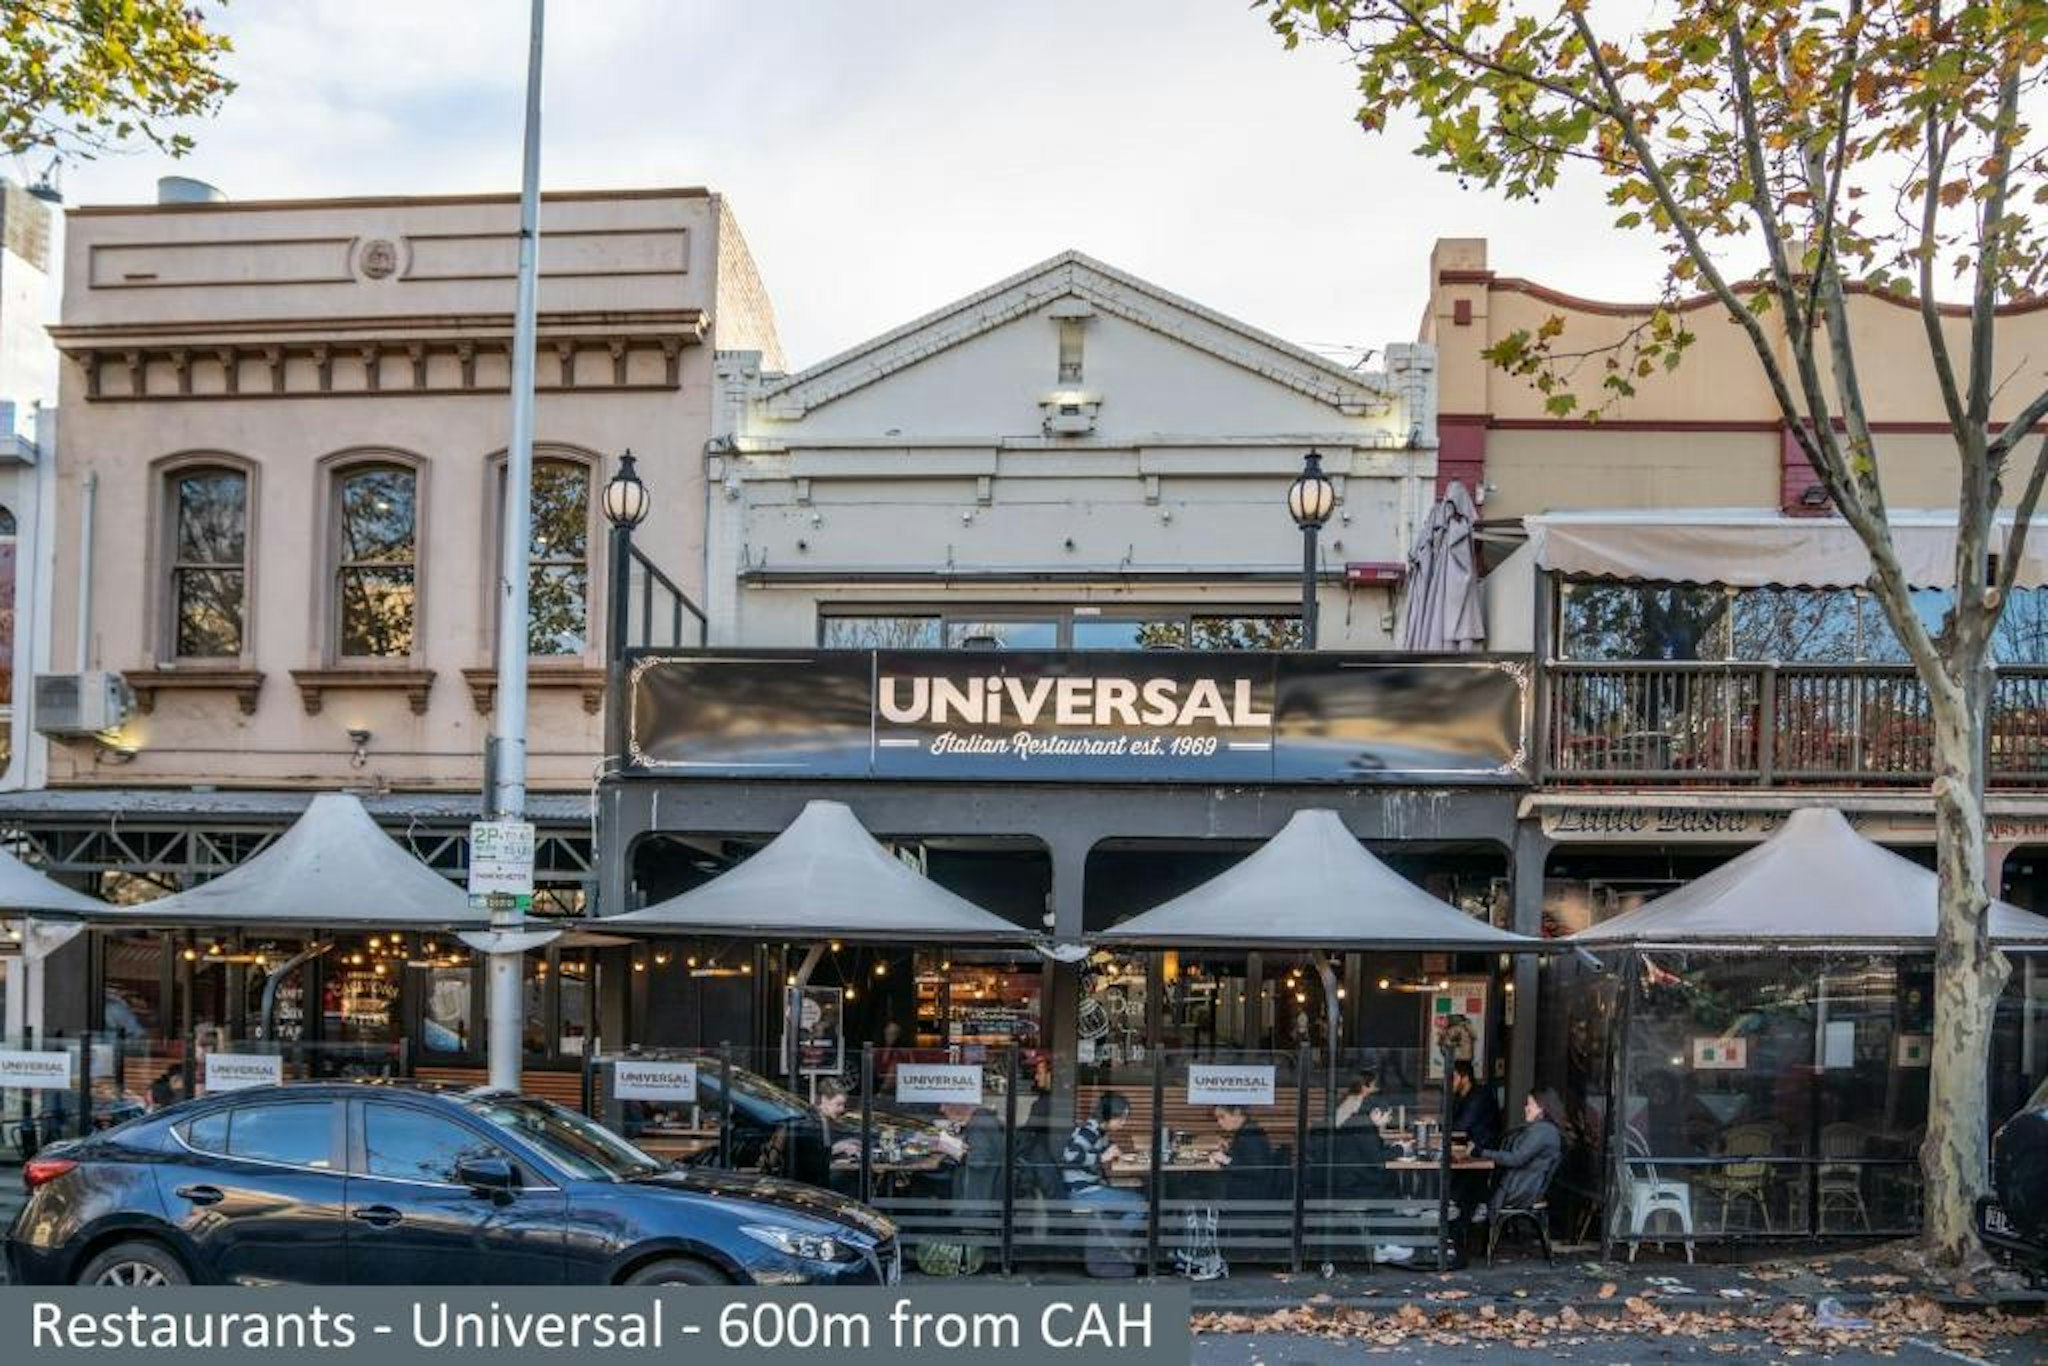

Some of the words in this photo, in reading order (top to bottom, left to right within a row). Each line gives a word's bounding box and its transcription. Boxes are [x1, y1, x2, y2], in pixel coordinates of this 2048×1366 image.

[930, 731, 1009, 756] Italian
[1009, 731, 1126, 760] Restaurant
[1130, 737, 1166, 756] est.
[1170, 735, 1218, 756] 1969
[474, 827, 498, 844] 2P
[2, 1060, 65, 1073] UNIVERSAL
[211, 1062, 277, 1076] UNIVERSAL
[620, 1071, 690, 1083] UNIVERSAL
[903, 1075, 976, 1086] UNIVERSAL
[1195, 1075, 1269, 1087] UNIVERSAL
